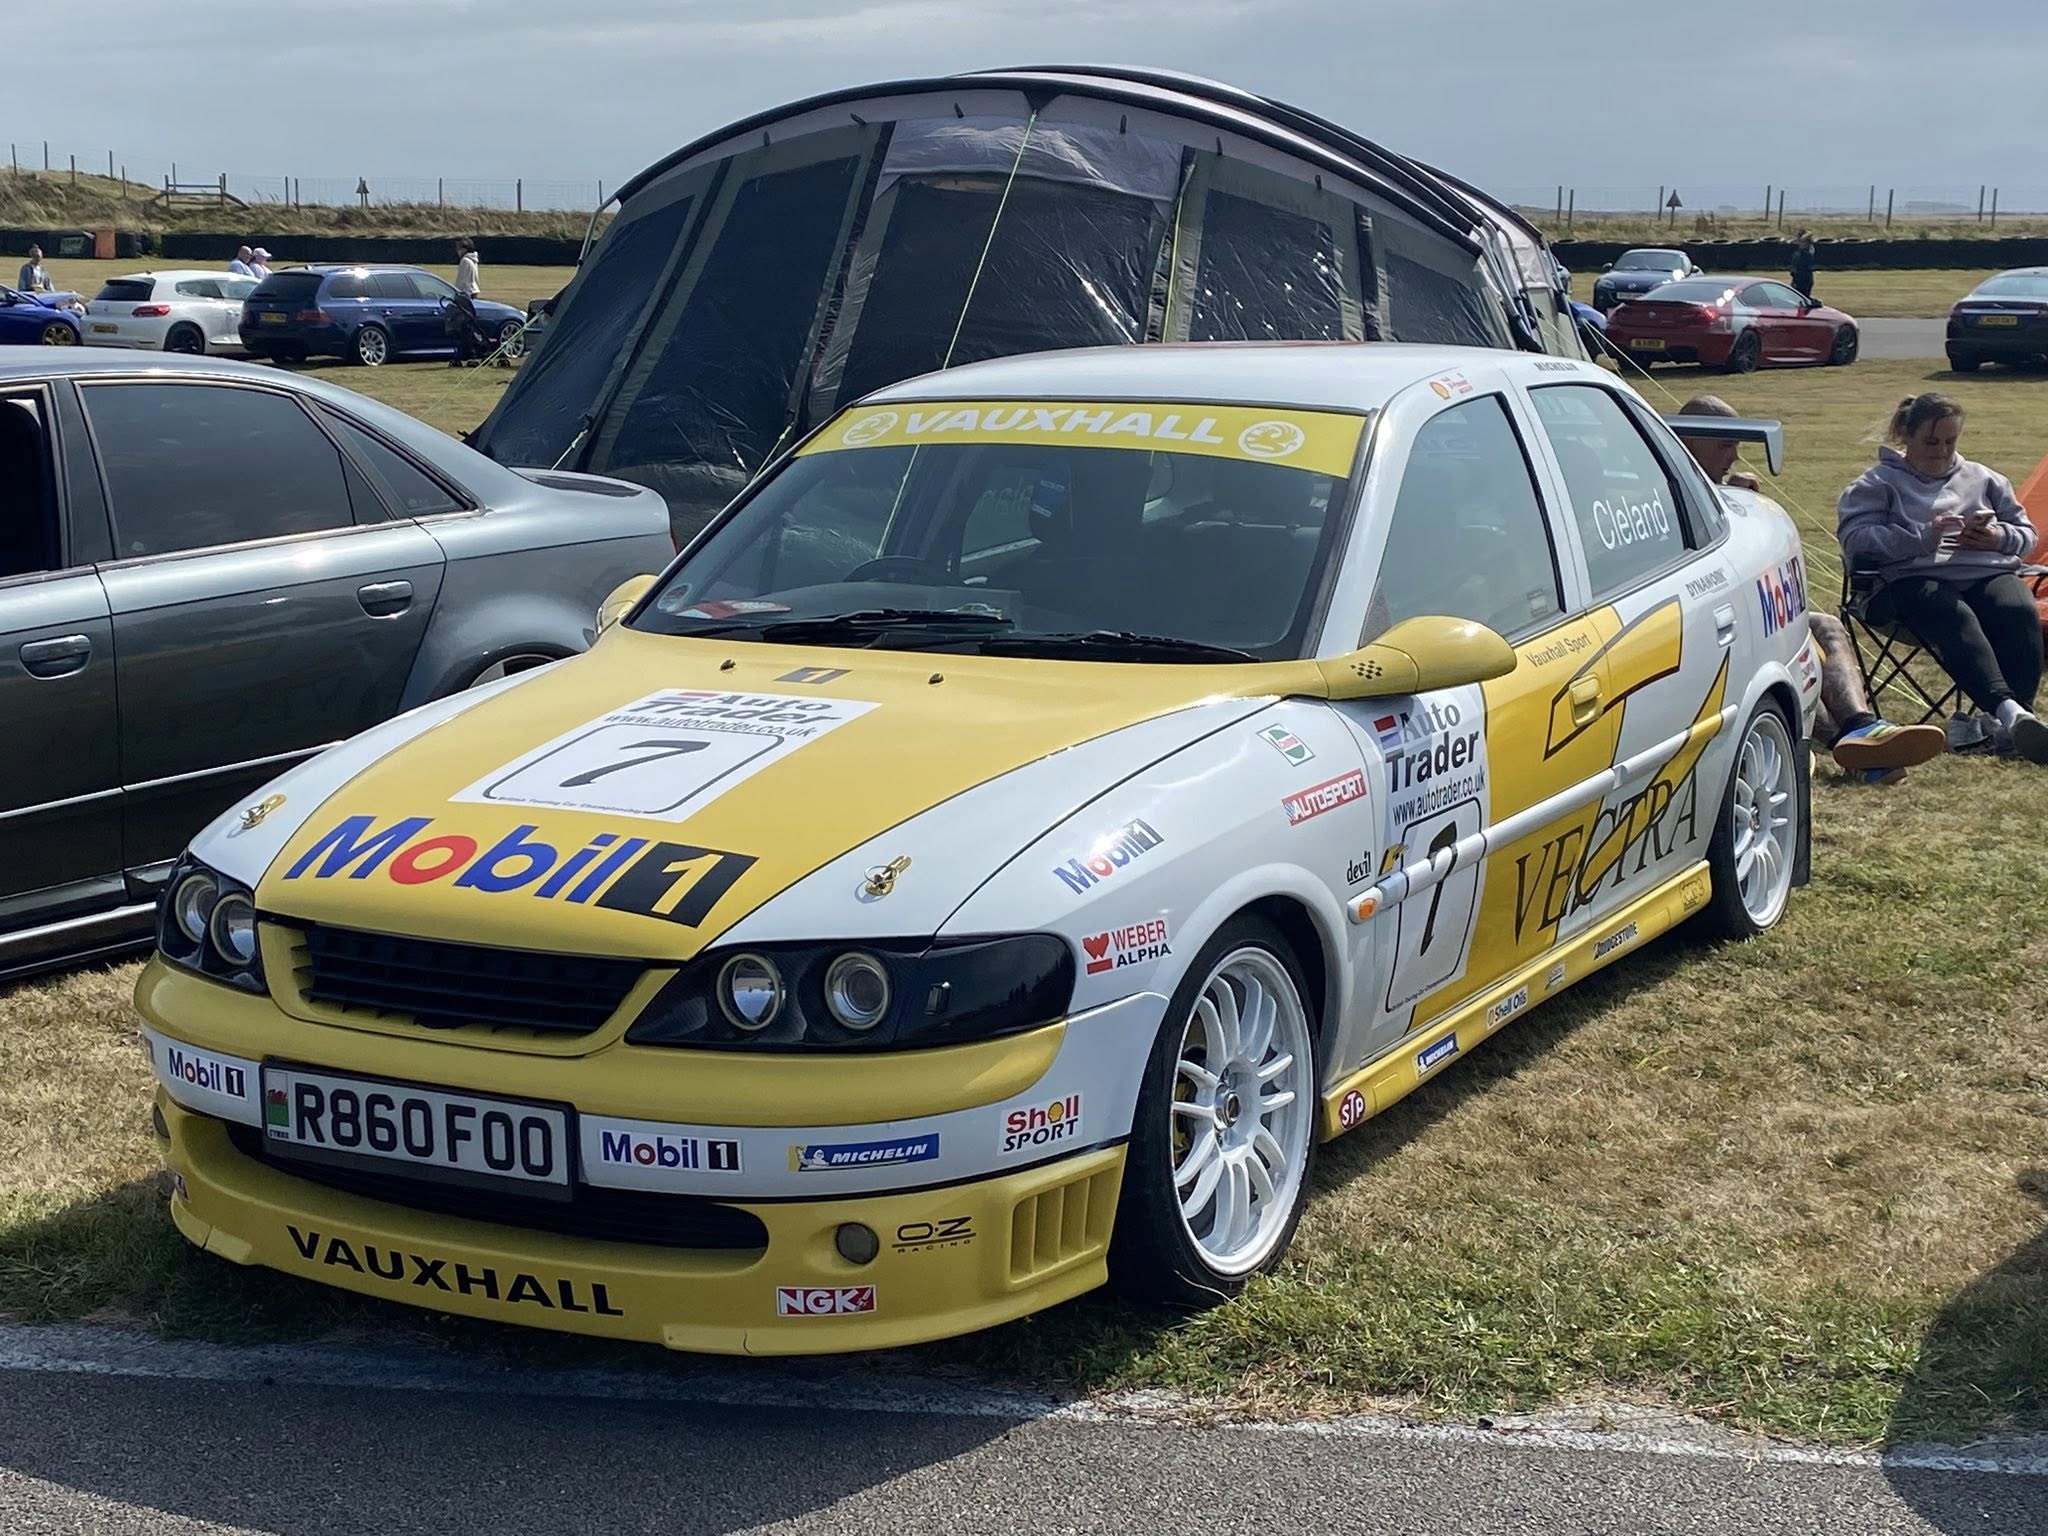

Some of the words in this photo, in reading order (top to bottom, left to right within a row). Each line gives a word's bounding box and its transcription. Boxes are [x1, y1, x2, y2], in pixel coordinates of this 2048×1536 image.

[904, 408, 1224, 444] VAUXHALL
[1592, 487, 1670, 551] Cleland
[1756, 559, 1800, 639] Mobil
[1524, 641, 1568, 668] Vauxhall
[1564, 633, 1593, 655] Sport
[627, 700, 843, 725] Trader
[704, 694, 833, 711] Auto
[604, 714, 818, 738] www.autotrader.co.uk
[1399, 702, 1461, 743] Auto
[559, 739, 712, 788] 7
[1385, 730, 1480, 794] Trader
[1292, 773, 1364, 821] AUTOSPORT
[1393, 765, 1486, 827] www.autotrader.co.uk
[282, 815, 650, 904] Mobil
[1346, 850, 1372, 883] devil
[1514, 765, 1698, 946] VECTRA
[1420, 820, 1458, 957] 7
[1112, 919, 1168, 952] WEBER
[1116, 942, 1172, 968] ALPHA
[1494, 998, 1512, 1022] Shell
[168, 1047, 222, 1092] Mobil
[1424, 1038, 1455, 1067] MICHELIN
[1006, 1095, 1080, 1134] Shll
[1340, 1091, 1364, 1126] STP
[294, 1082, 434, 1158] R860
[445, 1103, 553, 1178] FOO
[1003, 1117, 1079, 1152] SPORT
[602, 1131, 699, 1169] Mobil
[831, 1143, 928, 1164] MICHELIN
[897, 1239, 972, 1254] RACING
[286, 1224, 625, 1317] VAUXHALL
[779, 1288, 860, 1314] NGK
